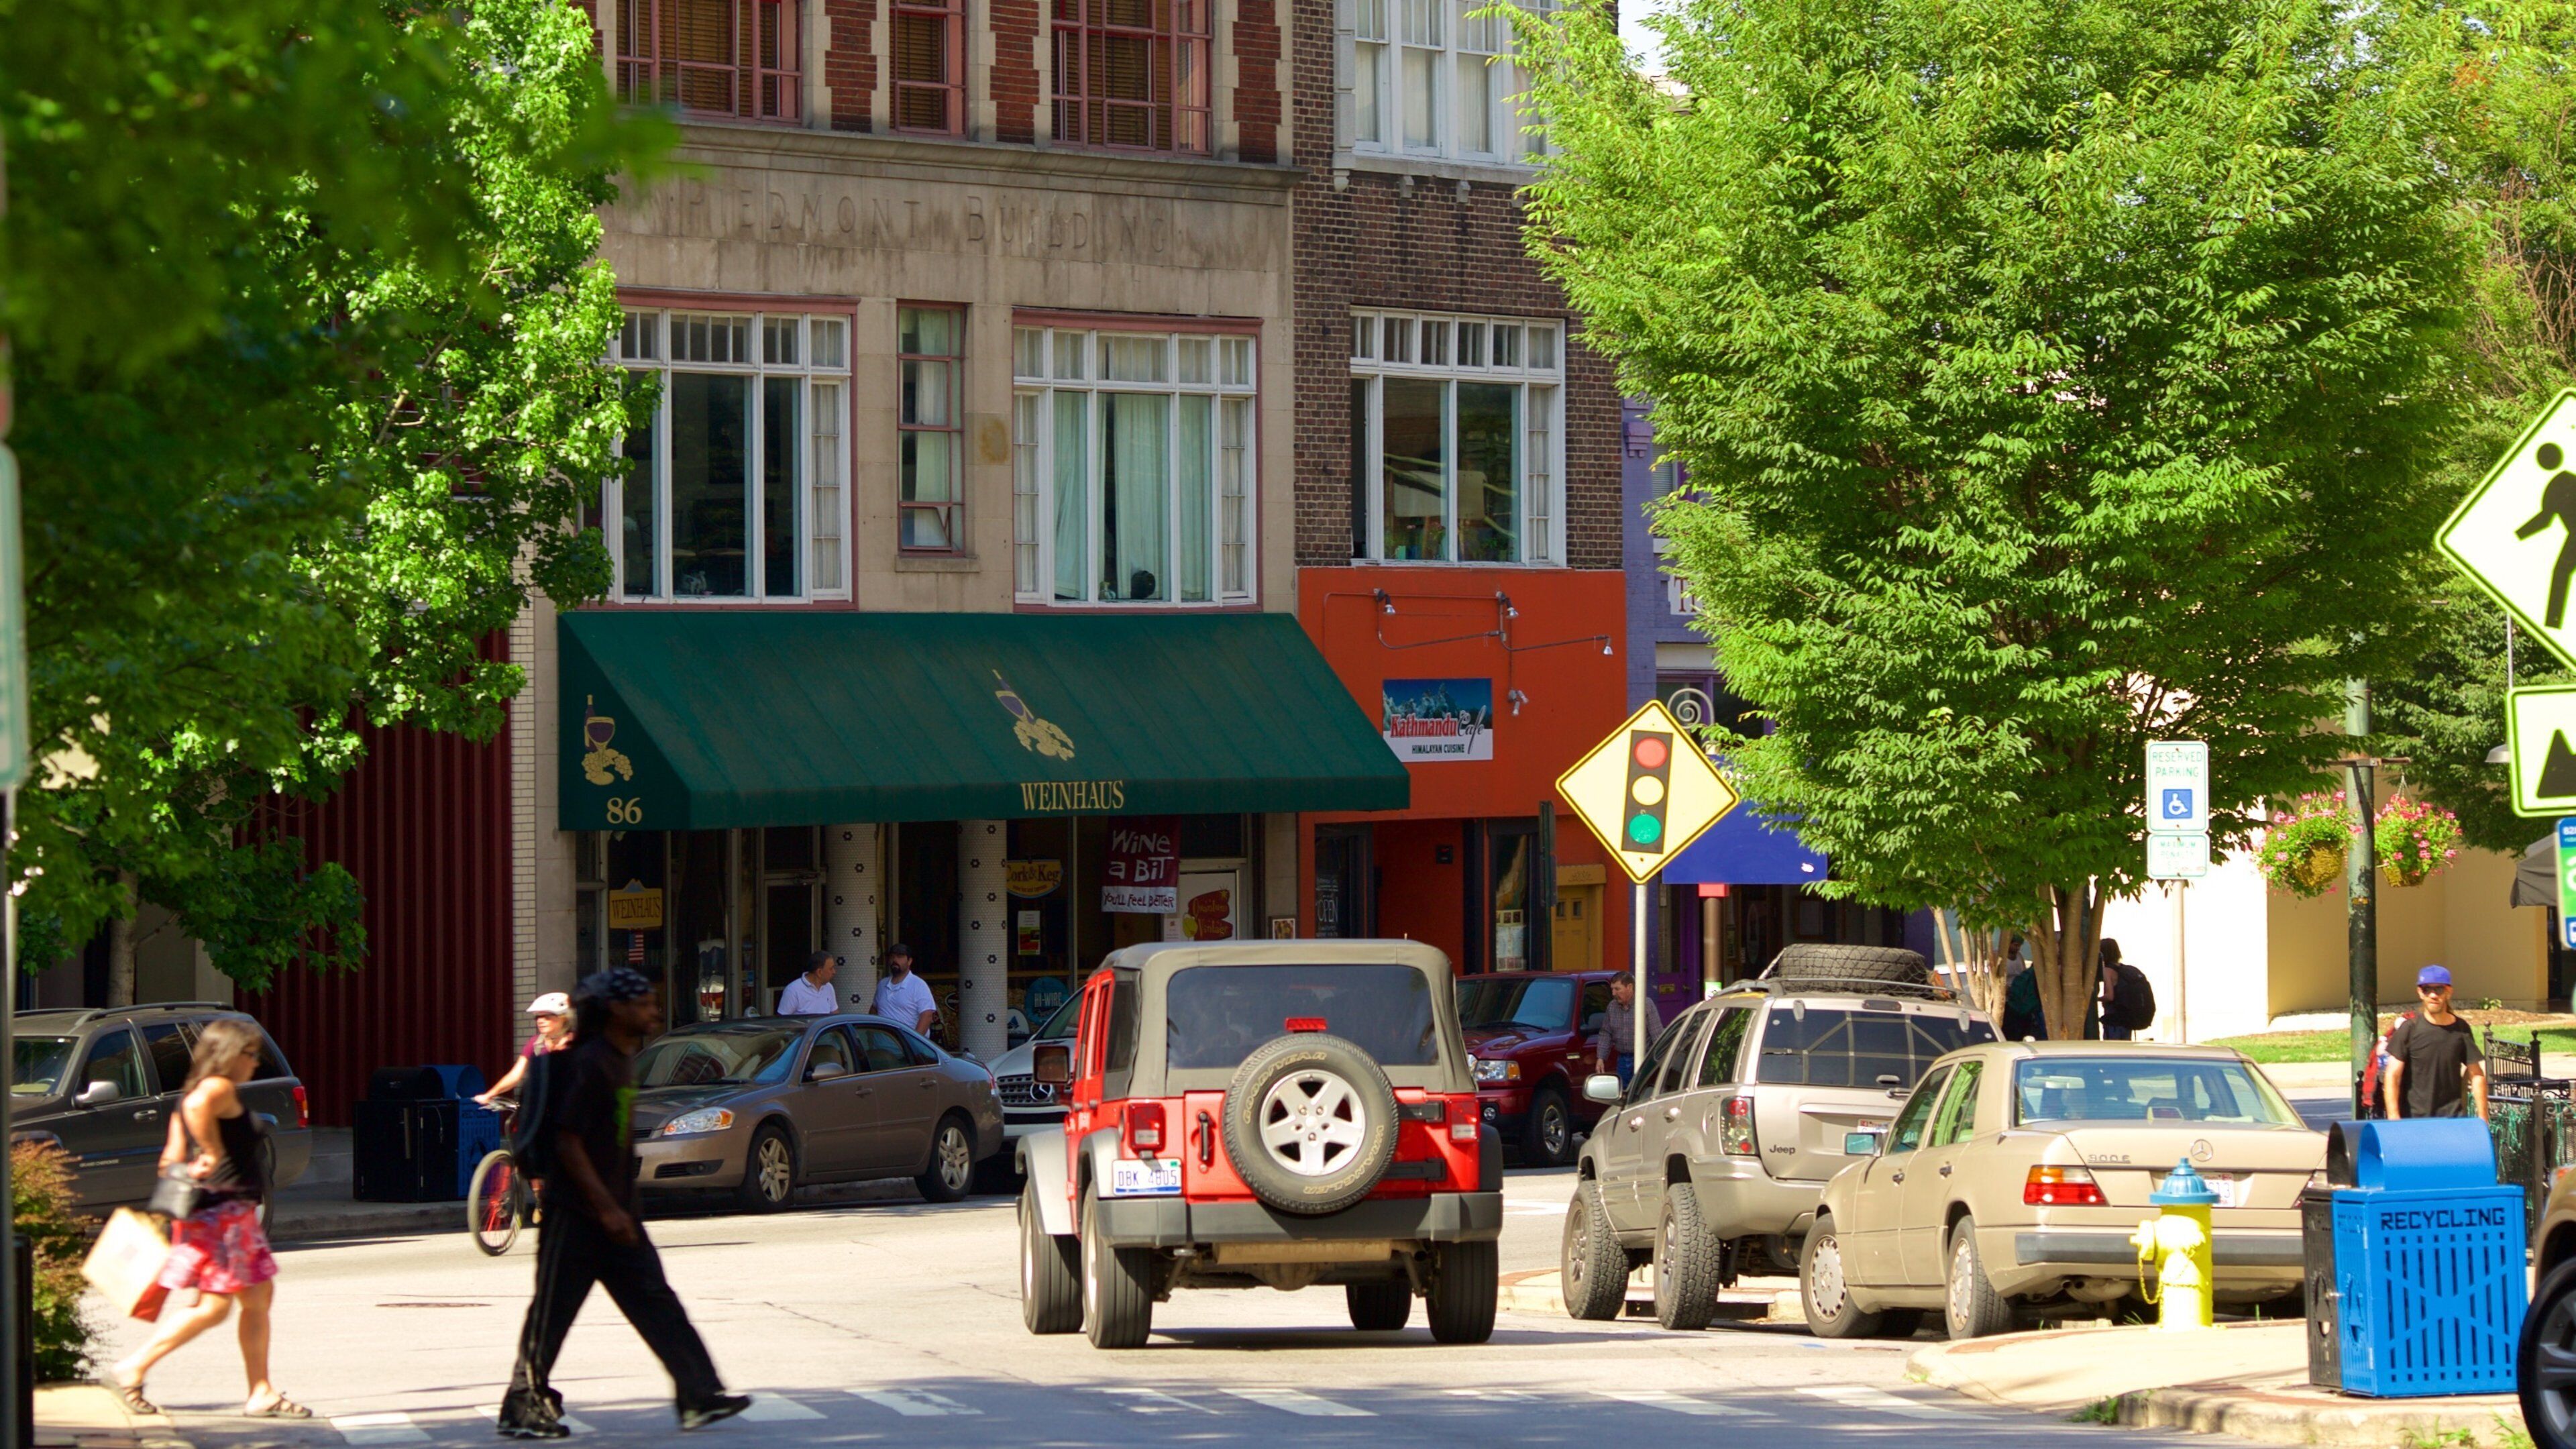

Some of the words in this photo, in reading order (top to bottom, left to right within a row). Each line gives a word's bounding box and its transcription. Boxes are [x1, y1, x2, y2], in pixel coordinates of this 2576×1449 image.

[688, 176, 921, 238] PIEDMONT
[967, 195, 1167, 253] BUILDING
[1391, 712, 1458, 737] Kathmandu
[1411, 745, 1442, 753] HIMALAYAN
[1444, 743, 1464, 753] CUISINE
[2152, 751, 2204, 762] RESERVED
[2155, 767, 2199, 777] PARKING
[1020, 780, 1124, 812] WEINHAUS
[606, 796, 643, 824] 86
[611, 896, 661, 919] WEINHAUS
[1034, 992, 1063, 1008] HI-WIRE
[1242, 1051, 1327, 1125] GOODYEAR
[1303, 1124, 1385, 1195] WRANGLER
[1770, 1144, 1796, 1155] Jeep
[1118, 1171, 1138, 1187] DBK
[2381, 1208, 2505, 1230] RECYCLING
